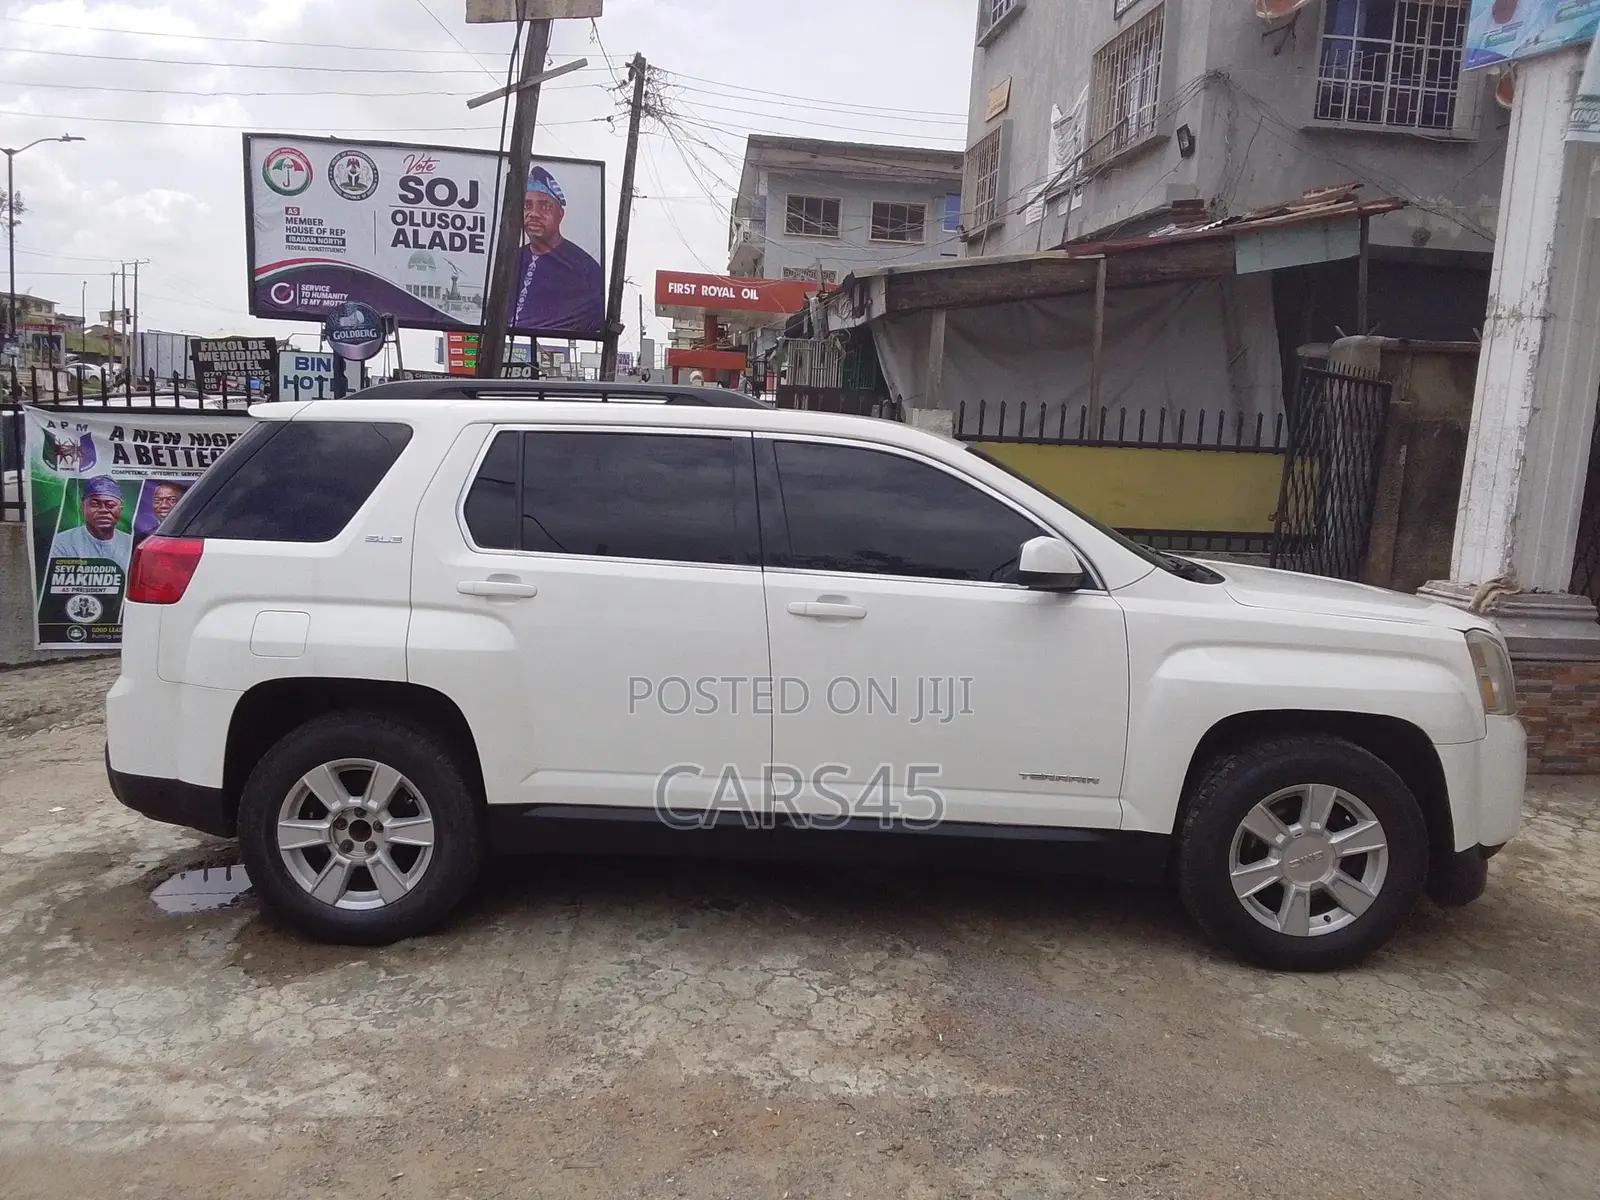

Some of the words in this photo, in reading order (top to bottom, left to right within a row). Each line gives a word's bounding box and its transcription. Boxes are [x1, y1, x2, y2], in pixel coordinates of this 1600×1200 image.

[403, 153, 440, 173] Vote
[398, 175, 480, 209] SOJ
[285, 217, 324, 226] MEMBER
[390, 209, 486, 233] OLUSOJI
[285, 226, 314, 235] HOUSE
[329, 228, 346, 237] REP
[318, 237, 343, 245] NORTH
[390, 228, 485, 254] ALADE
[308, 246, 346, 254] CONSTITUENCY
[301, 284, 331, 292] SERVICE
[668, 282, 697, 295] FIRST
[701, 285, 736, 299] ROYAL
[741, 288, 759, 300] OIL
[311, 292, 348, 300] HUMANITY
[333, 328, 378, 340] GOLDBERG
[200, 341, 246, 352] FAKOL
[247, 340, 267, 350] DE
[198, 350, 271, 362] MERIDIAN
[213, 361, 262, 371] MOTEL
[295, 356, 332, 372] BIN
[109, 425, 125, 442] A
[132, 428, 182, 445] NEW
[188, 432, 244, 447] NIGE
[112, 443, 131, 465] A
[54, 565, 76, 573] SEYI
[76, 565, 117, 574] ABIODUN
[51, 573, 122, 586] MAKINDE
